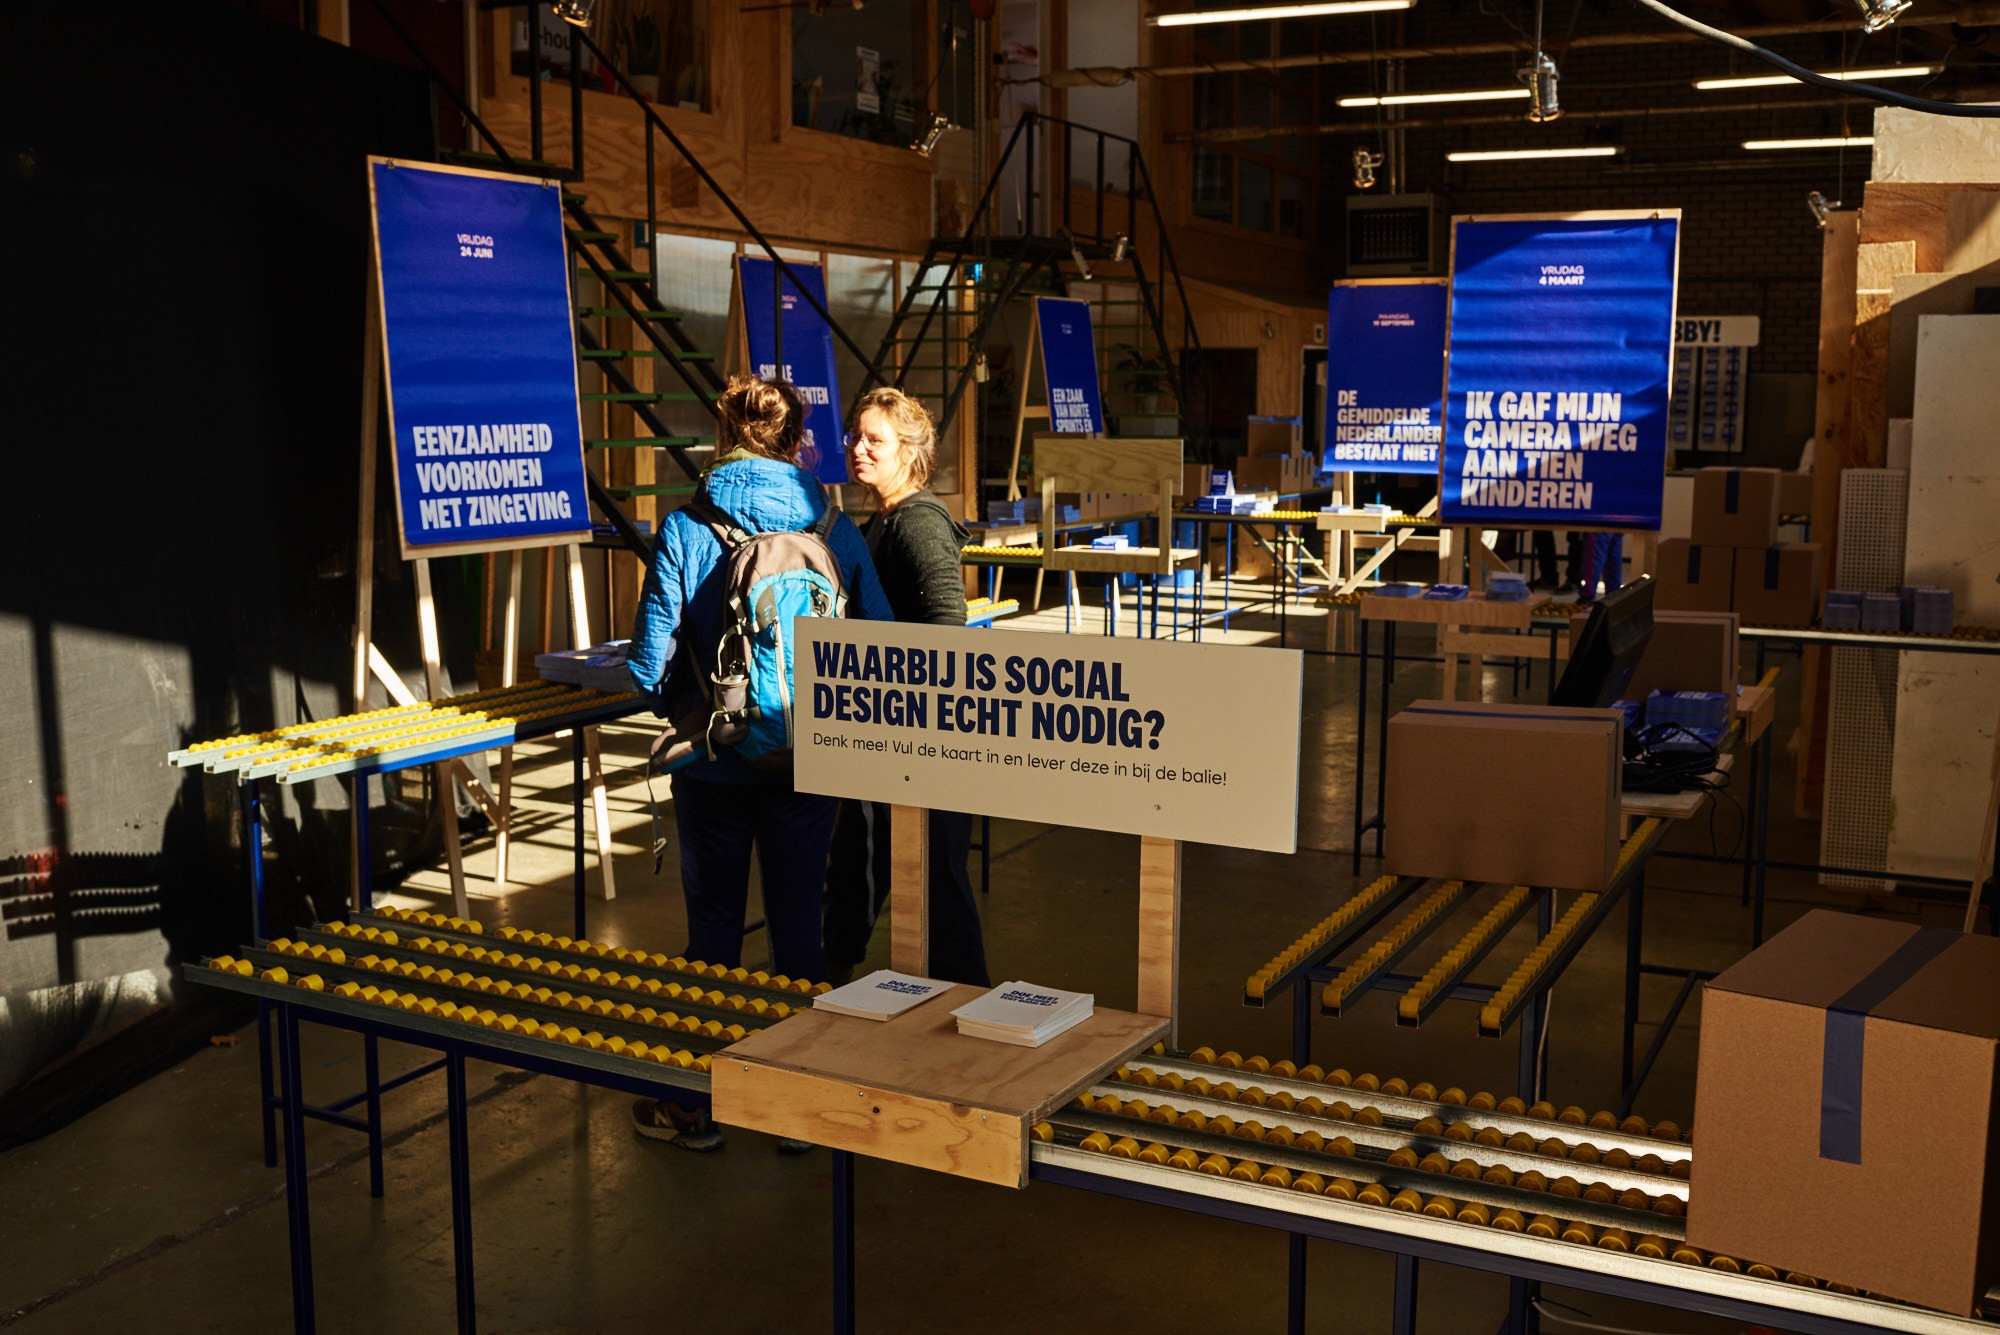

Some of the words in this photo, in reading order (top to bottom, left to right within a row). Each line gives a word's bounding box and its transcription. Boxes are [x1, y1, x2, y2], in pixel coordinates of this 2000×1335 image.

[456, 233, 494, 247] VRIJDAG
[460, 245, 472, 257] 24
[473, 247, 494, 259] JUNI
[1540, 264, 1584, 275] VRIJDAG
[1538, 275, 1547, 286] 4
[1548, 275, 1586, 286] MAART
[1052, 387, 1066, 403] EEN
[1337, 389, 1358, 406] DE
[1054, 403, 1069, 418] VAN
[1465, 391, 1495, 420] IK
[1498, 391, 1552, 421] GAF
[1555, 392, 1622, 422] MIJN
[1084, 418, 1094, 432] EN
[1336, 407, 1431, 425] GEMIDDELDE
[412, 423, 553, 457] EENZAAMHEID
[1335, 425, 1442, 443] NEDERLANDER
[1464, 420, 1573, 451] CAMERA
[1578, 422, 1637, 452] WEG
[1334, 443, 1401, 461] BESTAAT
[1402, 444, 1439, 462] NIET
[1462, 449, 1519, 479] AAN
[1524, 451, 1584, 480] TIEN
[415, 458, 543, 493] VOORKOMEN
[1460, 478, 1593, 509] KINDEREN
[419, 497, 462, 530] MET
[466, 490, 572, 527] ZINGEVING
[812, 641, 956, 689] WAARBIJ
[965, 652, 997, 692] IS
[1005, 656, 1130, 702] SOCIAL
[813, 683, 928, 729] DESIGN
[937, 693, 1023, 738] ECHT
[1031, 701, 1166, 751] NODIG?
[813, 732, 849, 750] Denk
[852, 738, 888, 752] mee!
[892, 740, 913, 755] Vul
[917, 742, 937, 758] de
[941, 744, 983, 763] kaart
[986, 748, 999, 764] in
[1003, 754, 1023, 768] en
[1027, 753, 1066, 771] lever
[1070, 758, 1110, 775] deze
[1114, 761, 1127, 777] in
[1132, 762, 1151, 783] bij
[1155, 765, 1177, 781] de
[1182, 767, 1227, 785] balie!
[1011, 990, 1033, 998] DOE
